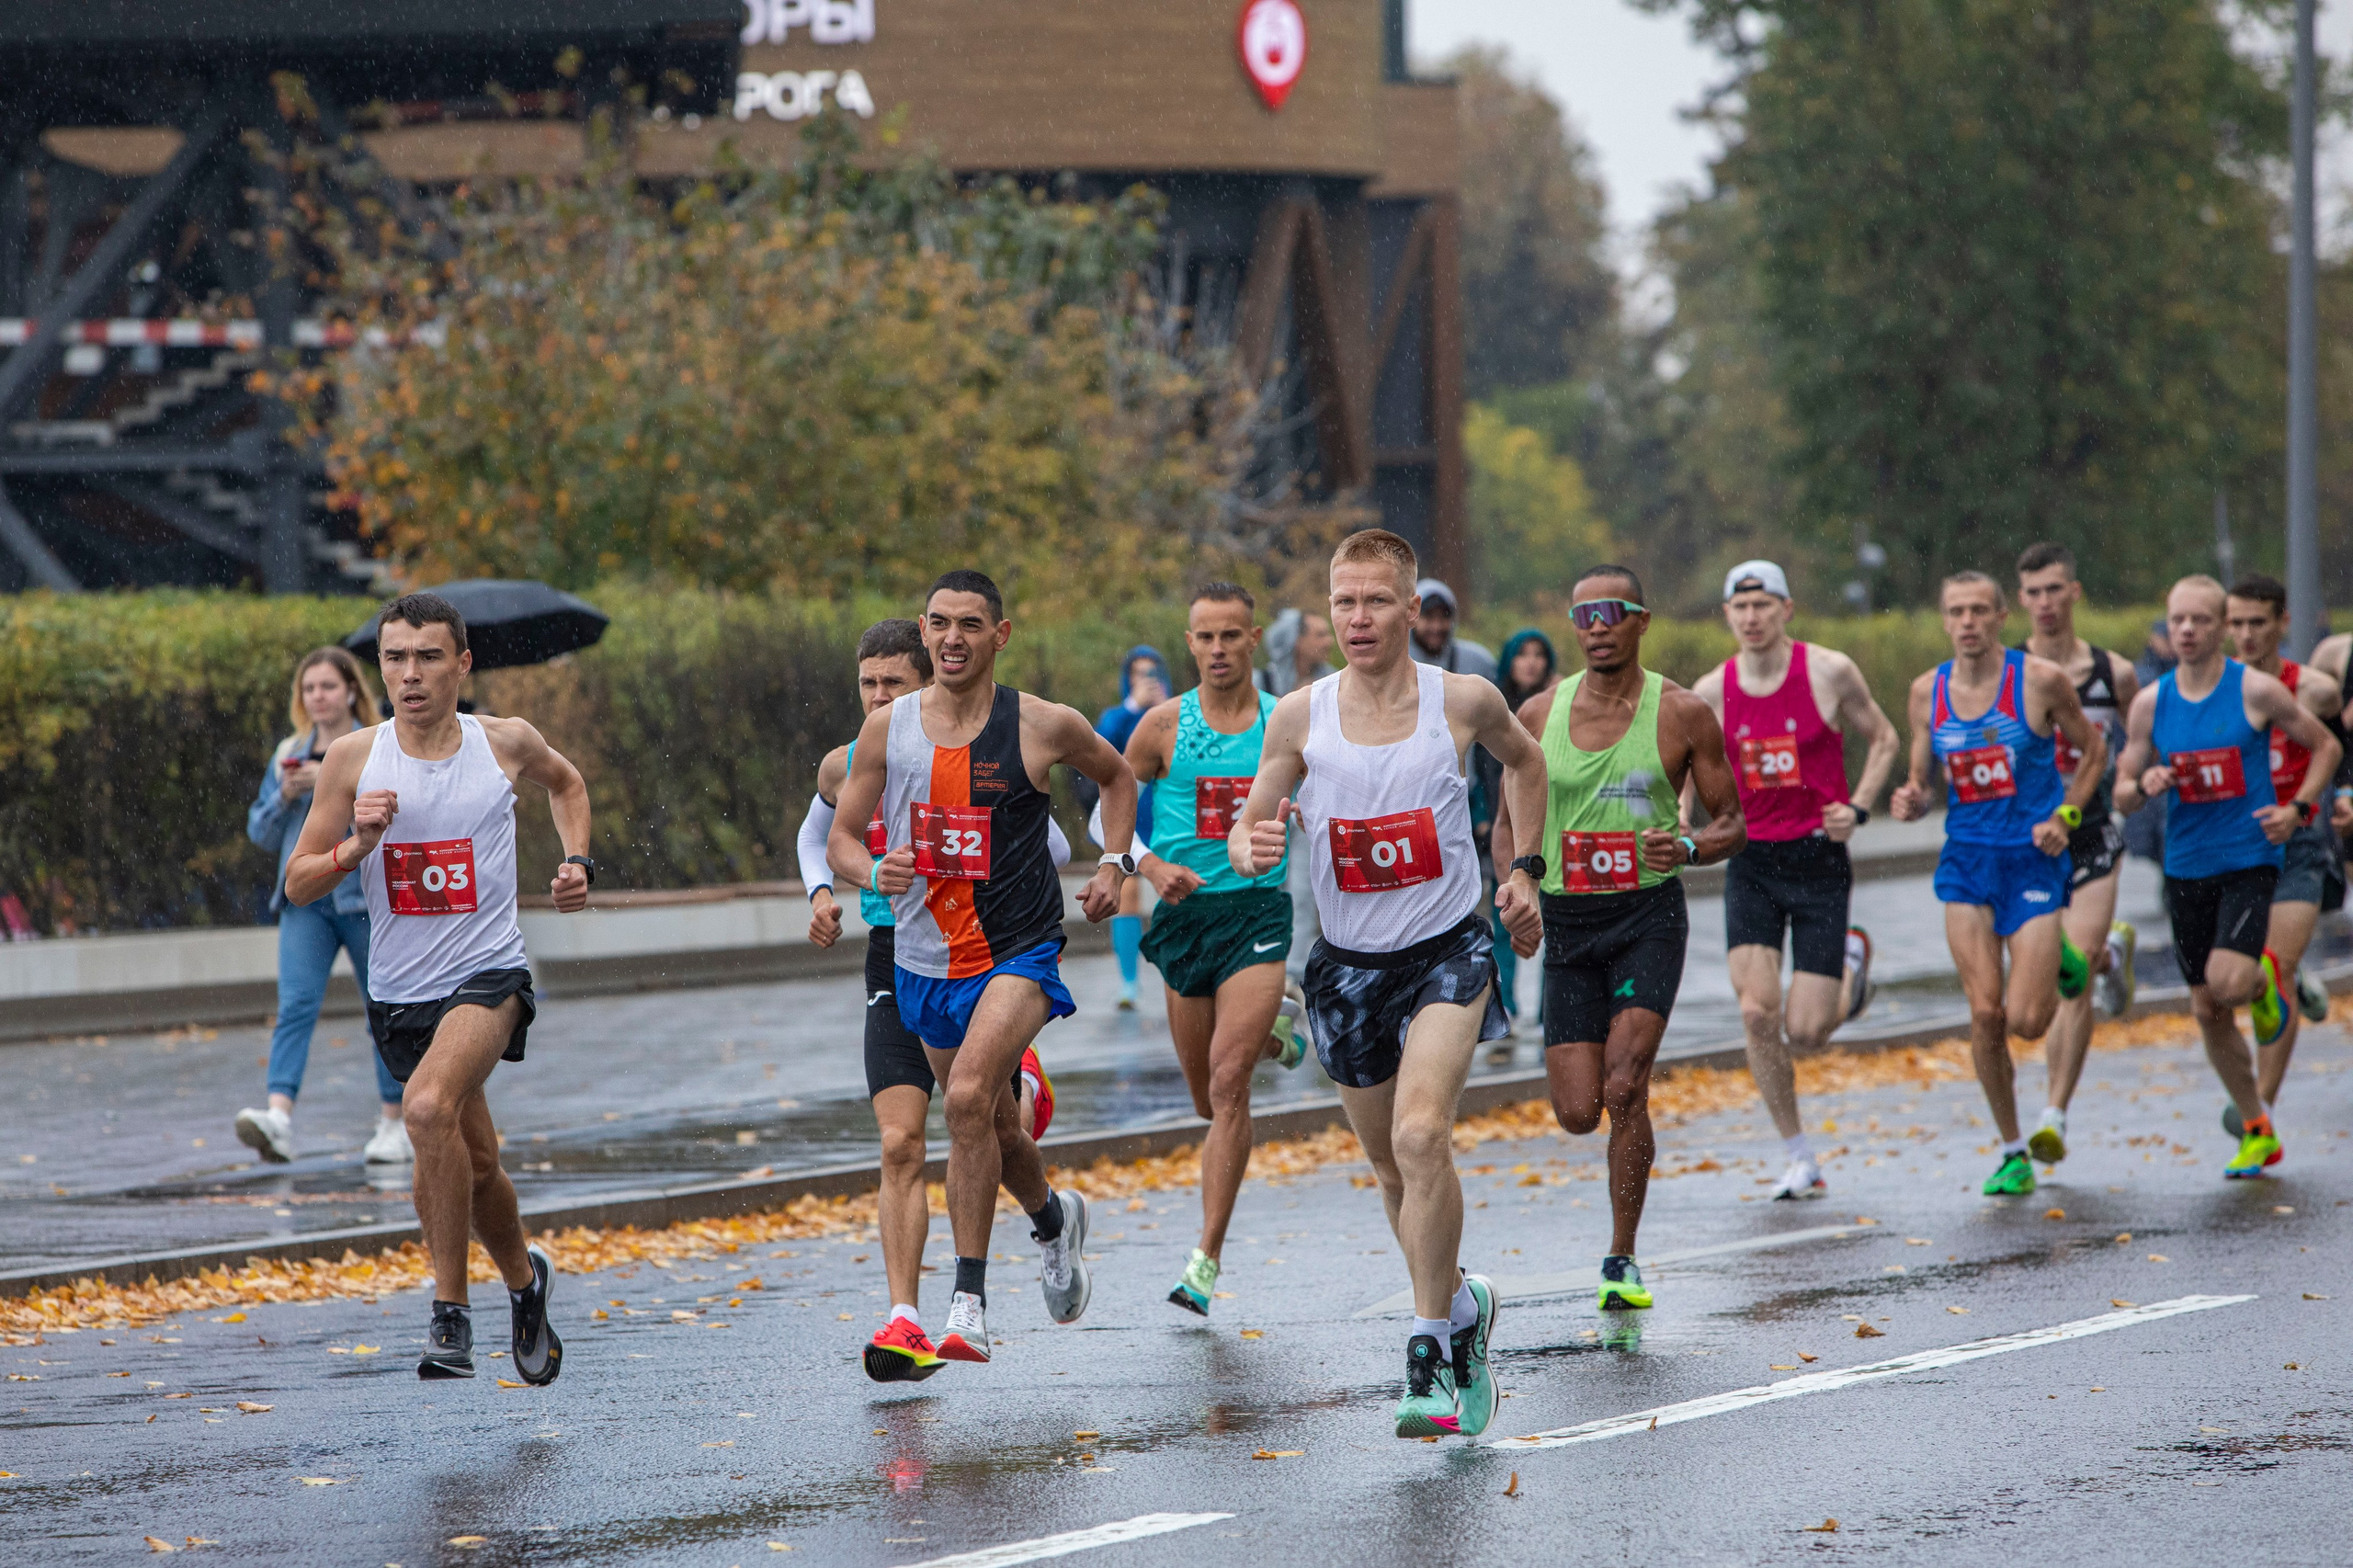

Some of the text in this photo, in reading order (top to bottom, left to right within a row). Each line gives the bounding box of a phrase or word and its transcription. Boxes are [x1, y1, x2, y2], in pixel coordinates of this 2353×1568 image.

[733, 69, 875, 121] РОГА
[1760, 750, 1795, 775] 20
[1972, 760, 2009, 786] 04
[2200, 764, 2224, 787] 11
[940, 829, 983, 857] 32
[1371, 836, 1414, 868] 01
[1591, 850, 1632, 873] 05
[422, 863, 469, 892] 03
